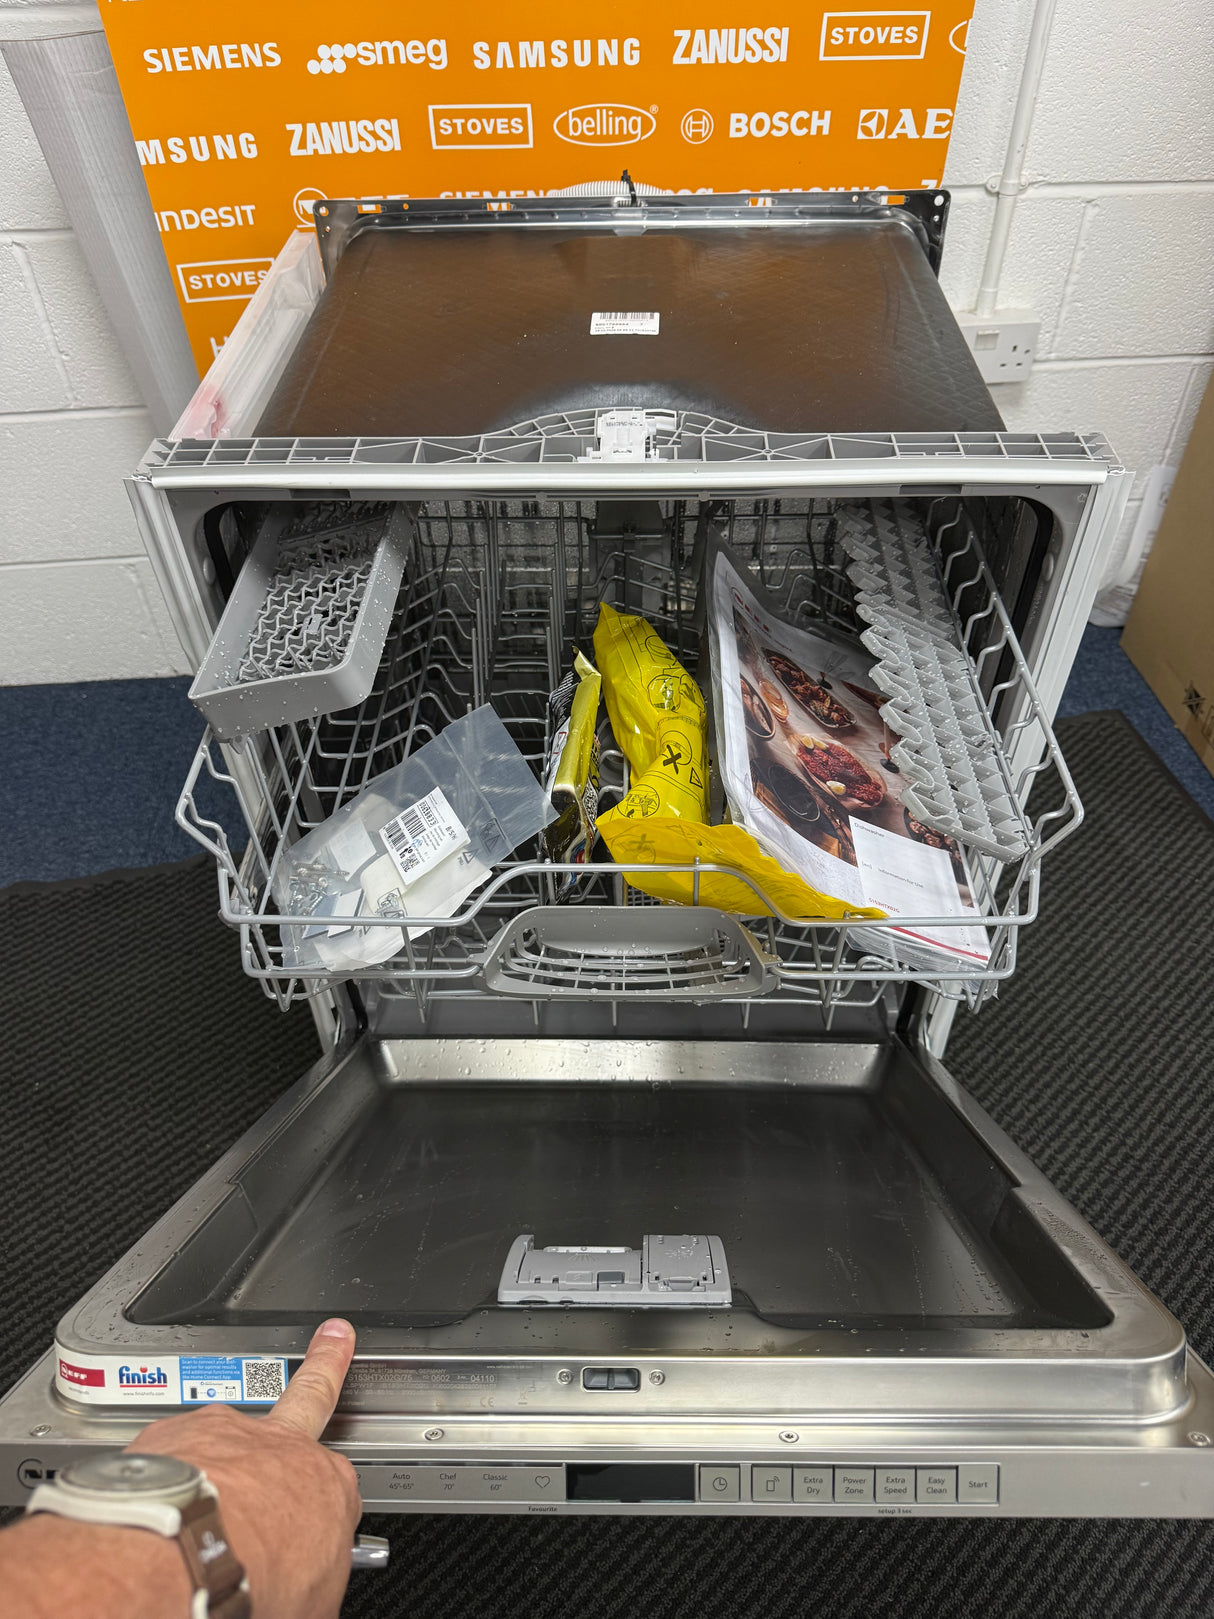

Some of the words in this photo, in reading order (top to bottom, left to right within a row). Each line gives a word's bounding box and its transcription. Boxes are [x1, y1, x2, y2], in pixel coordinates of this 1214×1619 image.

[672, 26, 791, 65] ZANUSSI
[830, 27, 920, 45] STOVES
[143, 43, 282, 74] SIEMENS
[357, 38, 449, 70] smeg
[472, 38, 641, 70] SAMSUNG
[438, 118, 525, 136] STOVES
[568, 109, 642, 139] belling
[728, 110, 833, 138] BOSCH
[285, 119, 403, 156] ZANUSSI
[118, 1366, 168, 1384] finish
[482, 1473, 508, 1481] Classic
[928, 1477, 946, 1485] Easy
[968, 1480, 988, 1488] Start
[883, 1487, 907, 1495] Speed
